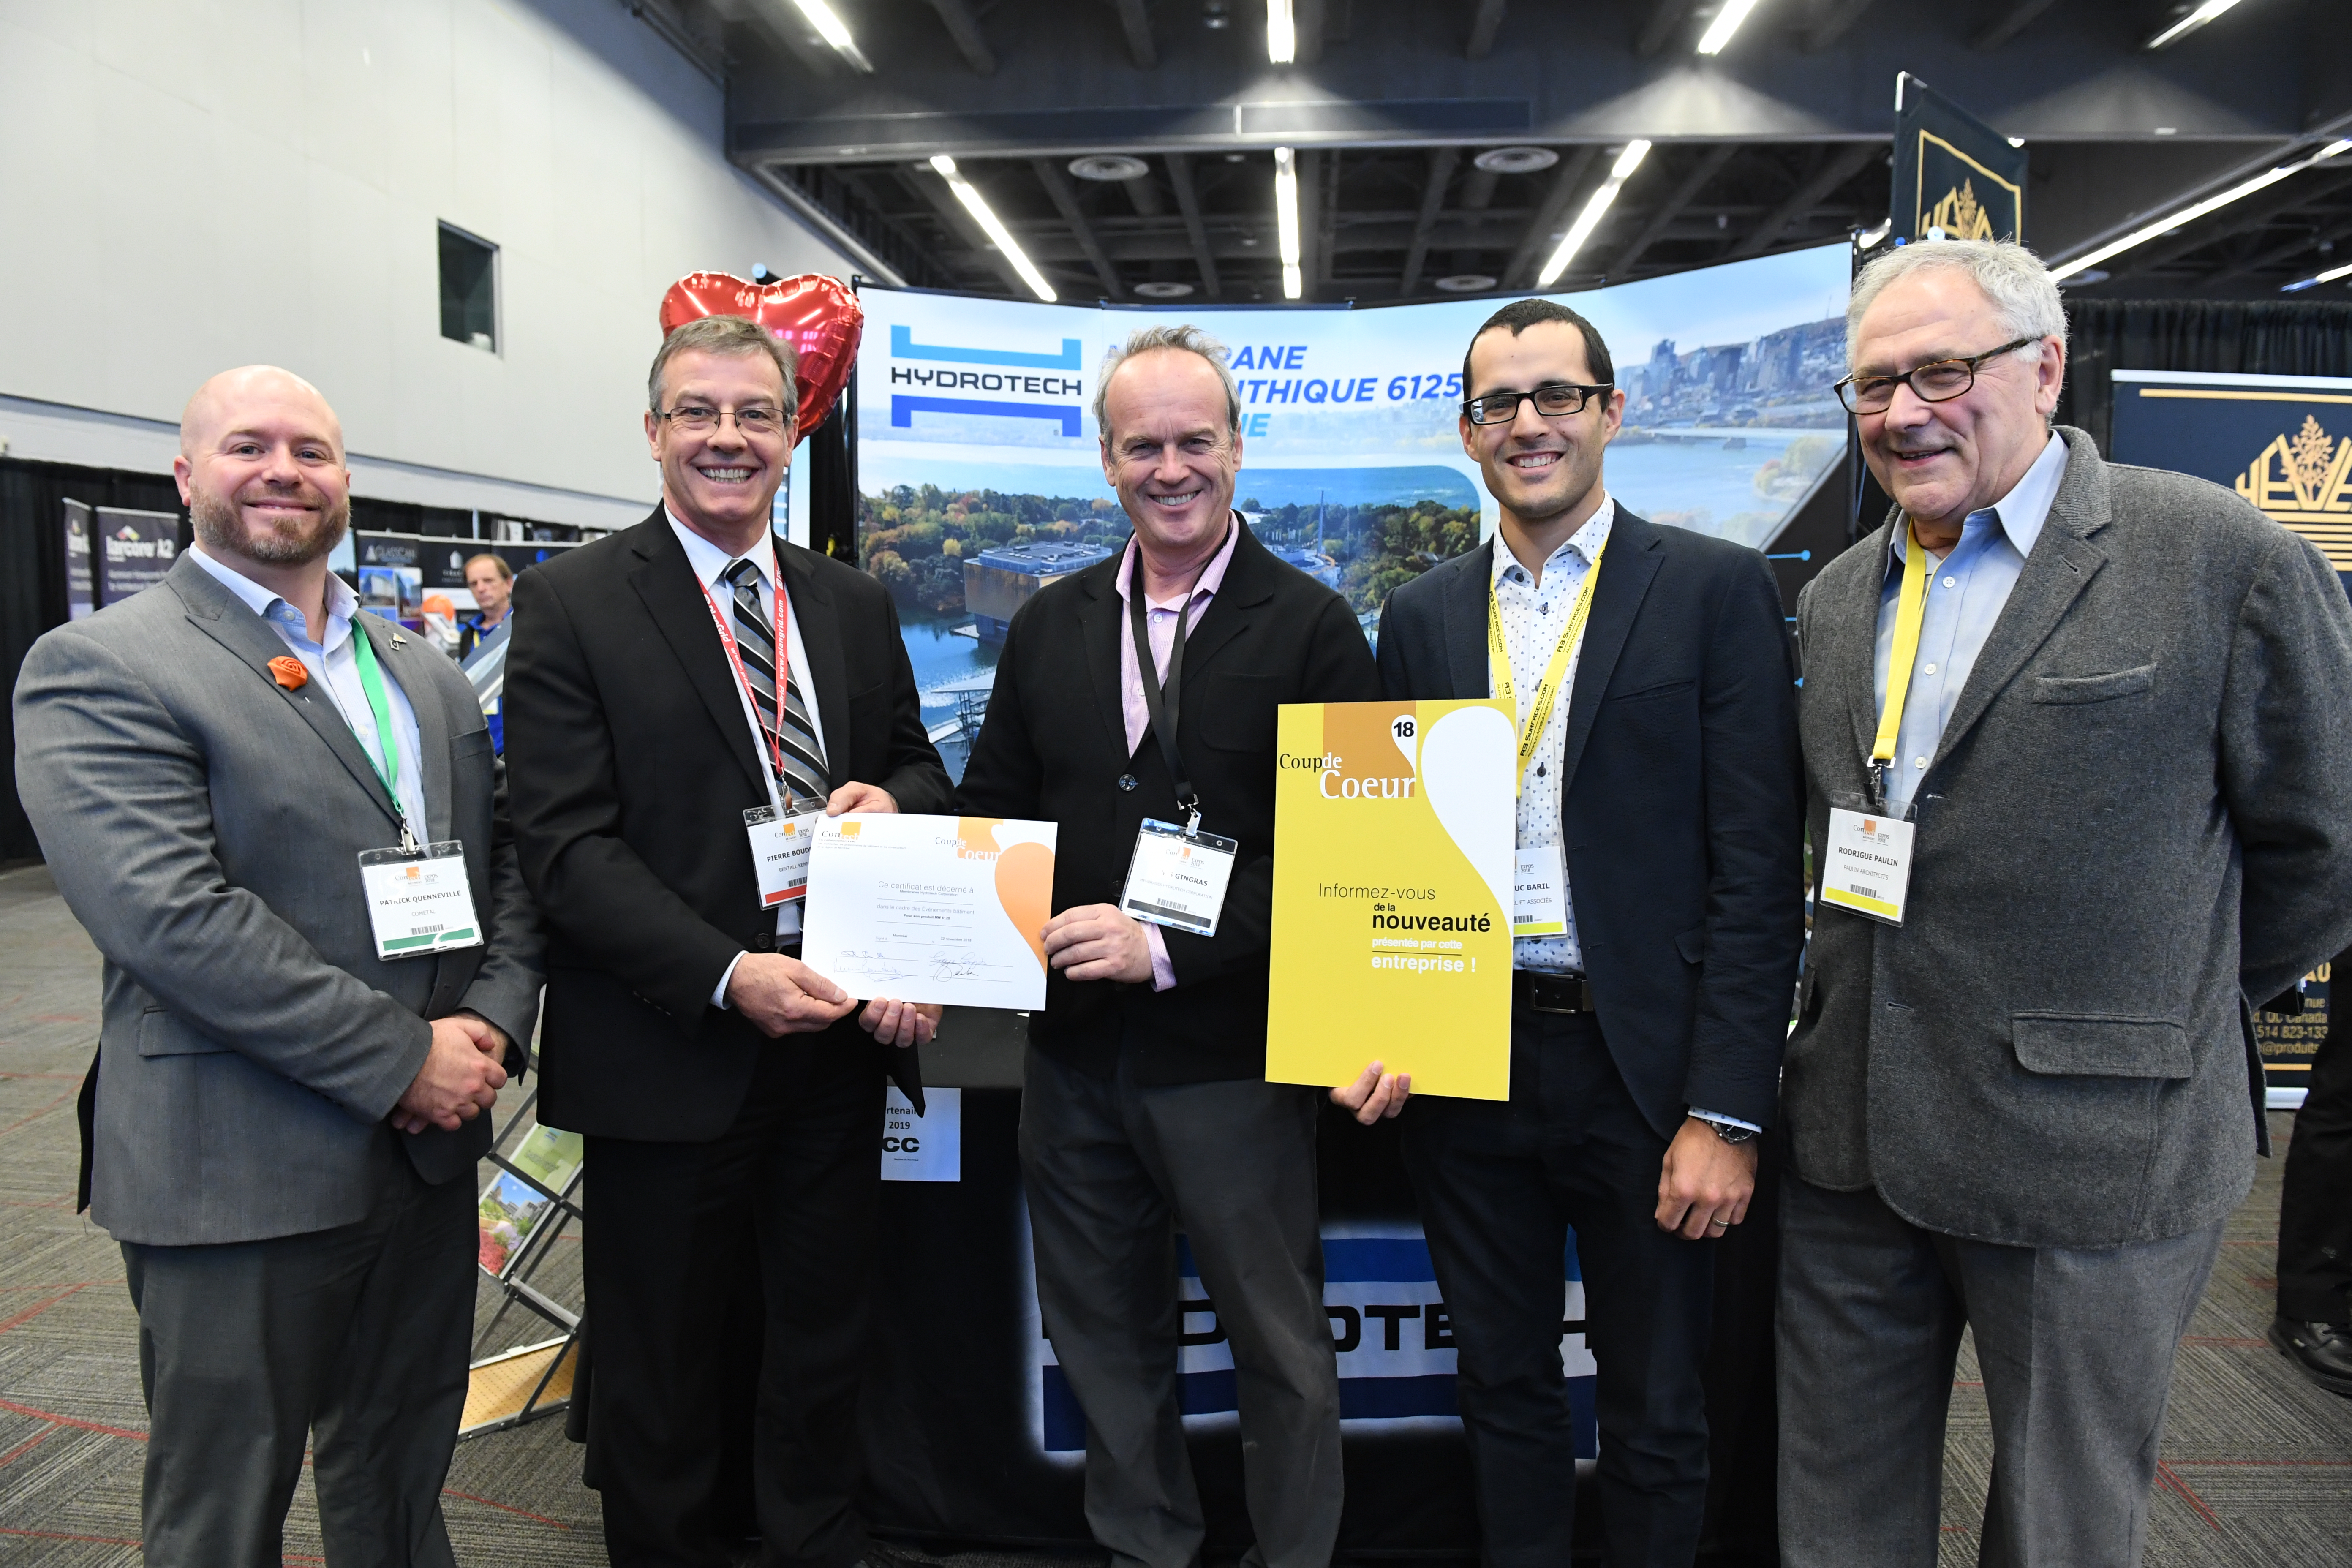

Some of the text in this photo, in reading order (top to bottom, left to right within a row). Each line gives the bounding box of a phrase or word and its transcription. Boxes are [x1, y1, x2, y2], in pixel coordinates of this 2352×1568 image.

[1226, 346, 1307, 370] ANE
[891, 367, 1081, 396] HYDROTECH
[1388, 373, 1463, 400] 6125
[777, 599, 785, 680] www.plangrid.com
[1393, 721, 1414, 738] 18
[1279, 752, 1342, 773] Coup de
[1320, 769, 1417, 799] Coeur
[935, 837, 957, 847] Coup
[767, 852, 790, 862] PIERRE
[956, 845, 1002, 861] Coeur
[1838, 847, 1898, 867] RODRIGUE PAULIN
[779, 864, 798, 873] BENTALL
[1843, 864, 1889, 880] PAULIN ARCHITECTES
[1175, 874, 1208, 886] GINGRAS
[412, 890, 461, 902] QUENNEVILLE
[936, 885, 967, 893] décerné
[1140, 878, 1212, 899] MEMBRANES HYDROTECH CORPORATION
[1319, 883, 1436, 900] Informez-vous
[1374, 903, 1396, 912] de la
[1527, 896, 1552, 904] ASSOCIÉS
[1372, 912, 1491, 932] nouveauté
[1372, 936, 1462, 950] présentée par cette
[1371, 955, 1476, 974] entreprise !
[889, 1121, 911, 1130] 2019
